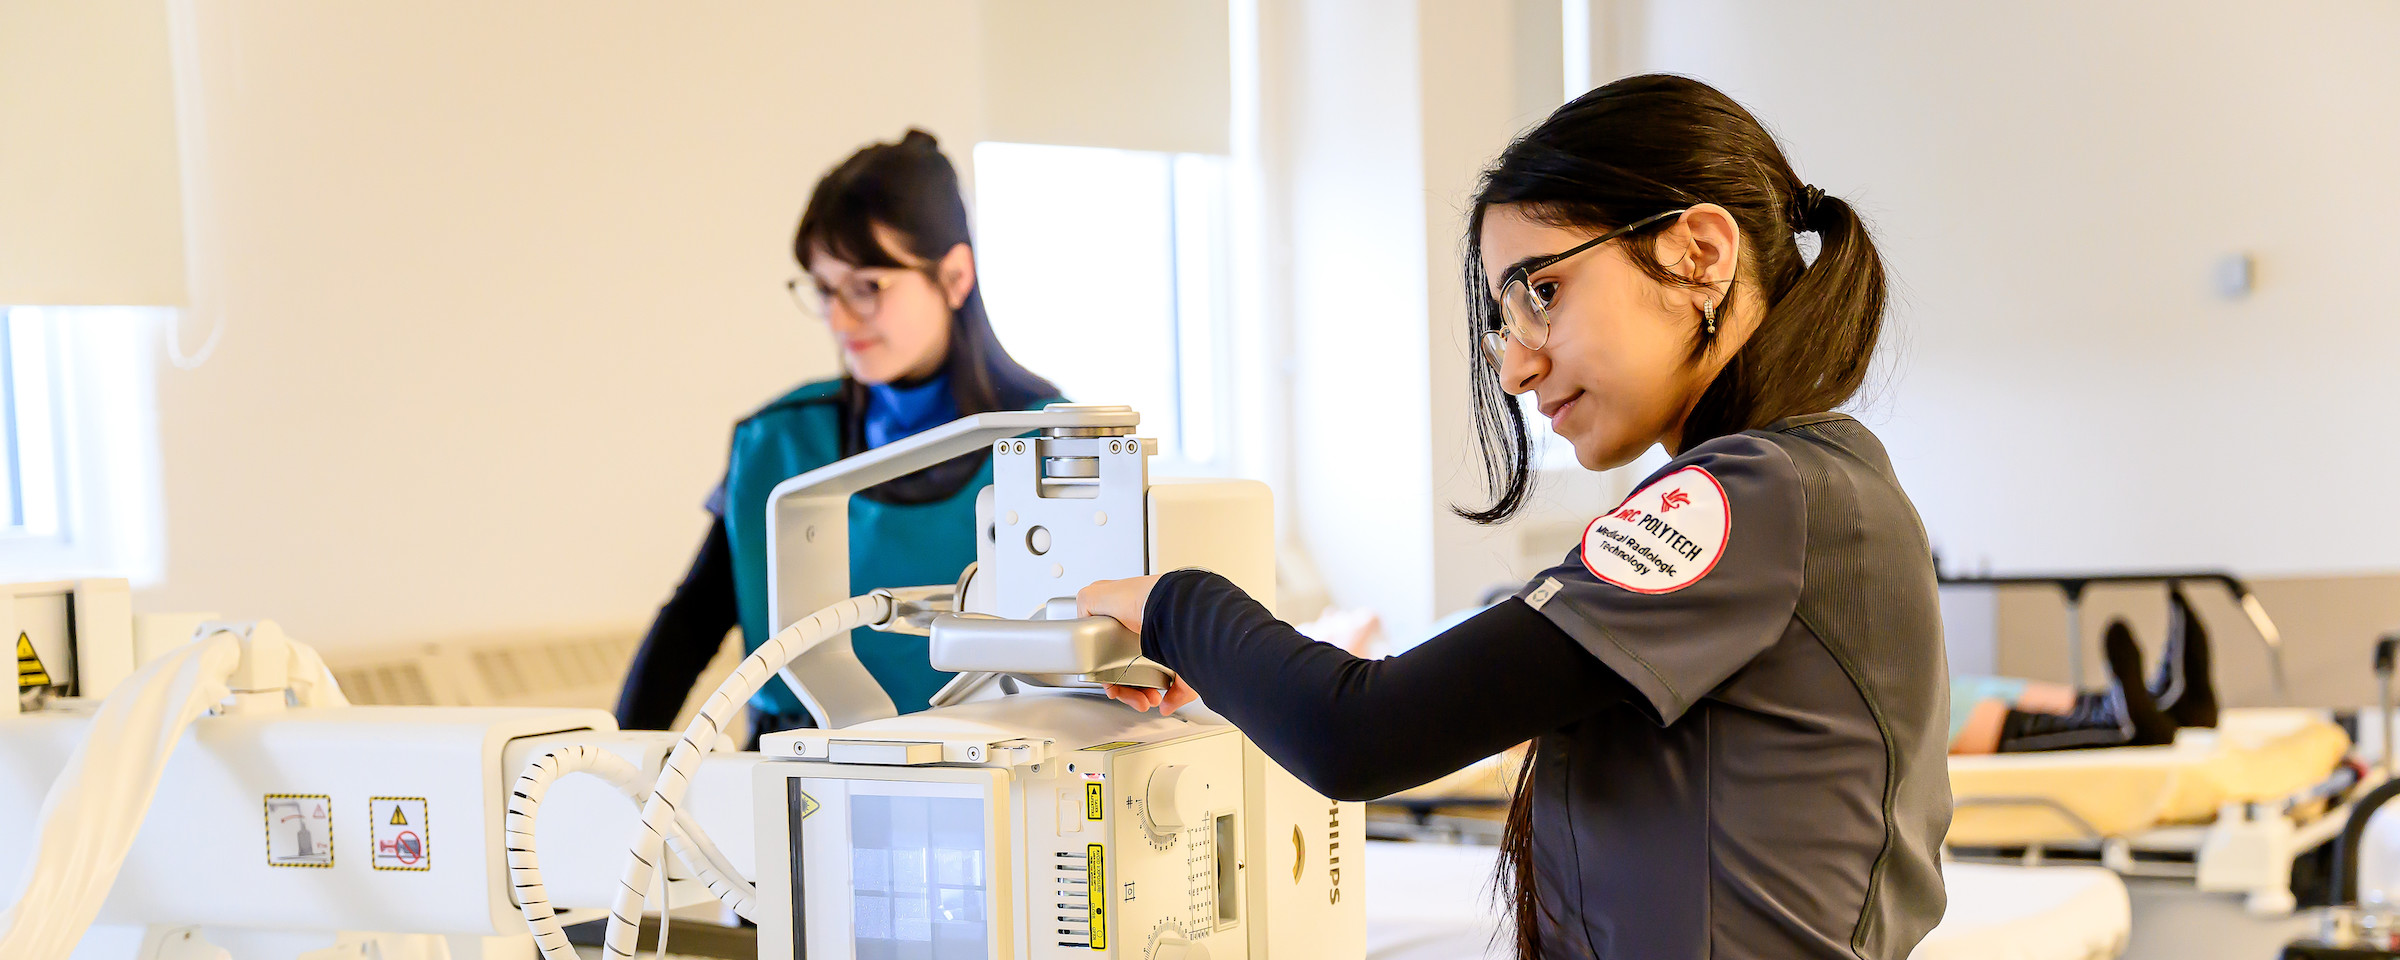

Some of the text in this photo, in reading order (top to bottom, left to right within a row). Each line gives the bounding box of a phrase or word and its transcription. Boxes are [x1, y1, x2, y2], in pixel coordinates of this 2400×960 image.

[1596, 525, 1677, 577] Medical Radiologic
[1600, 540, 1651, 575] Technology
[1638, 514, 1702, 562] POLYTECH
